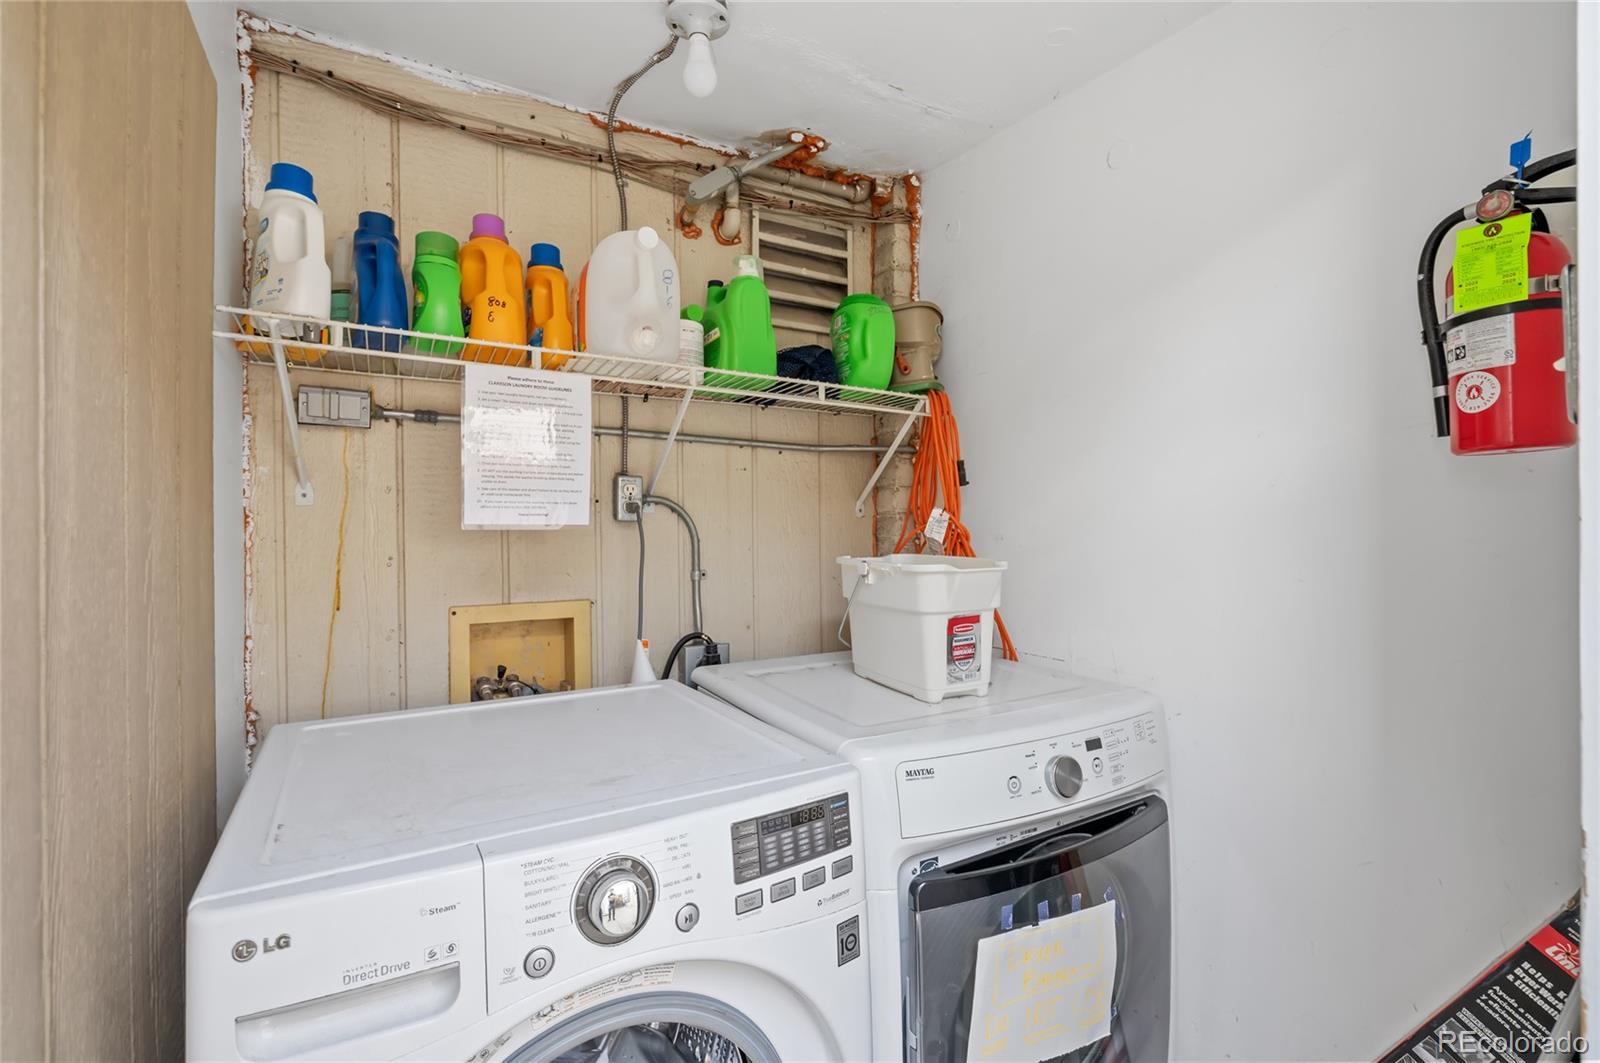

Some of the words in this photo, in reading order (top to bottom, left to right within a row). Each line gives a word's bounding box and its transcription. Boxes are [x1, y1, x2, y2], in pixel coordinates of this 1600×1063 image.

[488, 296, 506, 308] 808
[905, 768, 935, 778] MAYTAG
[428, 903, 457, 916] Steam
[524, 900, 552, 911] SANITARY
[537, 928, 555, 936] CLEAN
[262, 933, 291, 954] LG
[840, 933, 858, 956] 10
[342, 968, 379, 986] Direct
[380, 960, 411, 976] Drive
[1506, 973, 1514, 982] &
[1520, 961, 1554, 990] Helps
[1513, 967, 1541, 990] Dryer
[1538, 987, 1565, 1011] Work
[1479, 994, 1488, 1003] y
[1488, 999, 1521, 1029] eficiente
[1492, 985, 1518, 1008] Ayuda
[1524, 1012, 1551, 1036] mante
